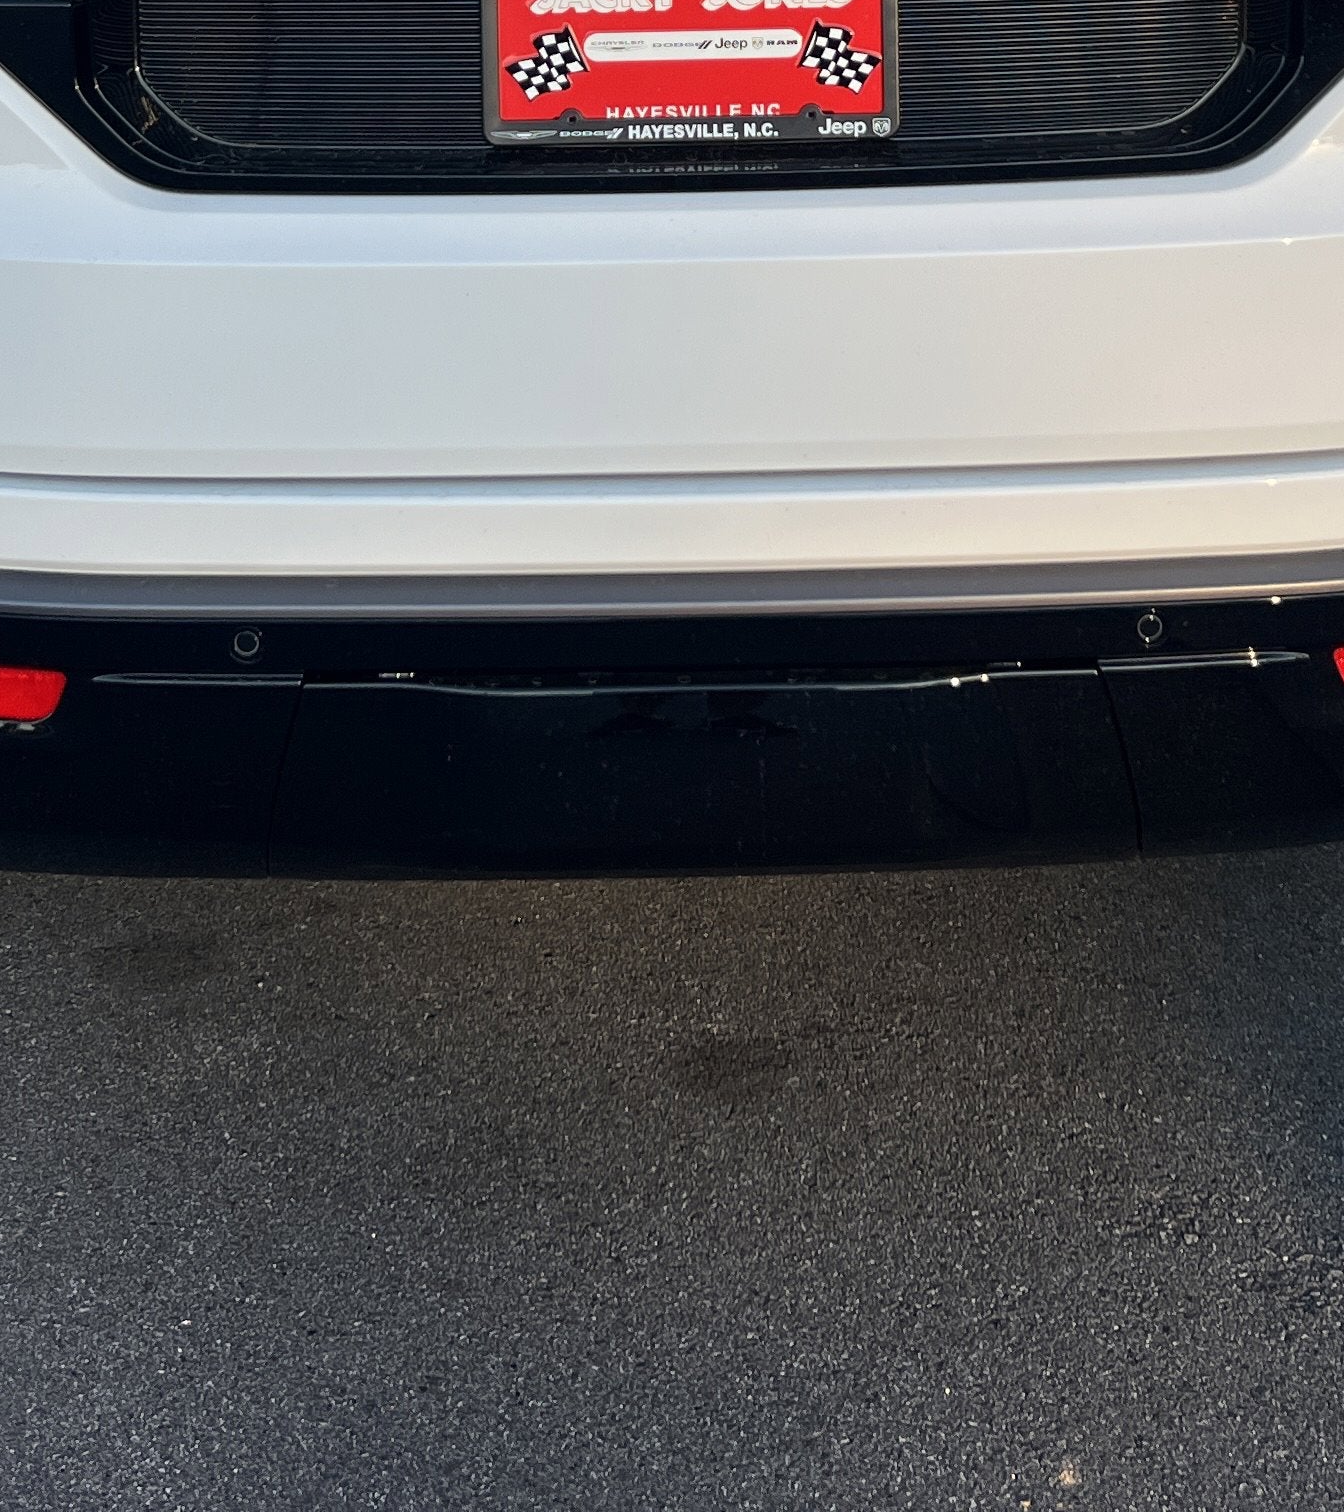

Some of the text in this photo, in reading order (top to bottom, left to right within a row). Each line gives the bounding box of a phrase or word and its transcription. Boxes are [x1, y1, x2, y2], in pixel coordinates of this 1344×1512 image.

[714, 38, 748, 50] Jeep
[628, 122, 739, 139] HAYESVILLE,
[743, 122, 779, 138] N.C.
[818, 118, 866, 137] Jeep
